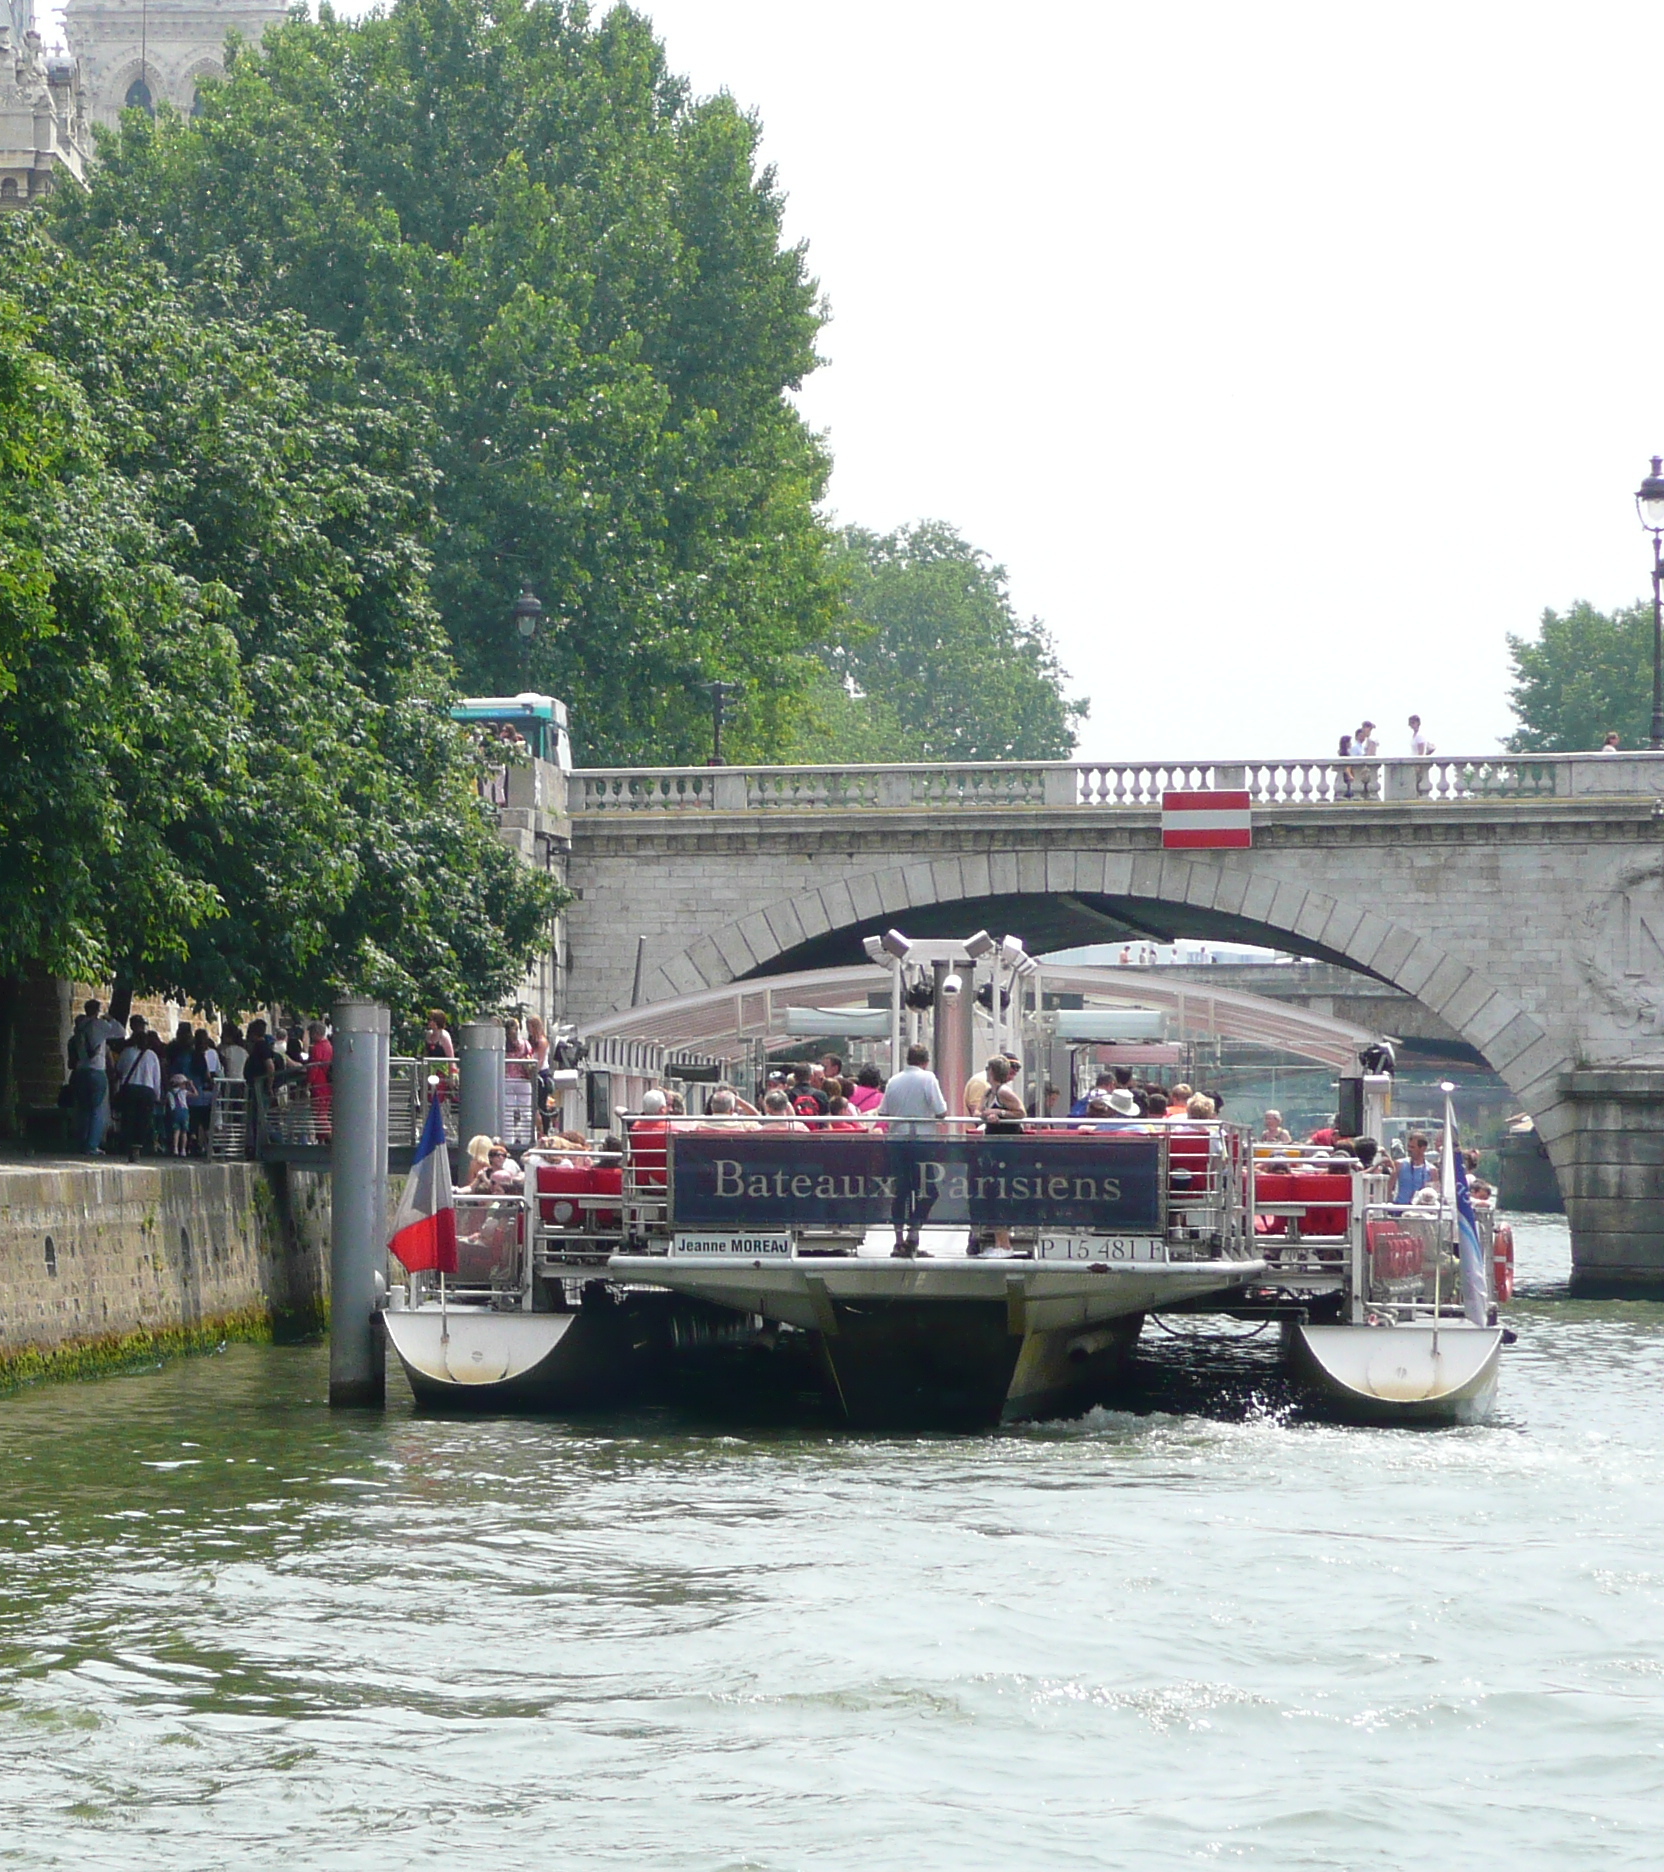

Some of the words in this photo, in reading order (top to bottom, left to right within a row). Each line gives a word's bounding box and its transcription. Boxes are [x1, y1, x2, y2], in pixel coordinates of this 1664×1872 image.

[712, 1159, 898, 1199] Bateaux
[915, 1161, 1122, 1201] Parisiens
[678, 1238, 726, 1252] Jeanne
[1040, 1239, 1055, 1259] P
[1066, 1239, 1090, 1259] 15
[1098, 1238, 1136, 1260] 481
[1149, 1240, 1164, 1260] F
